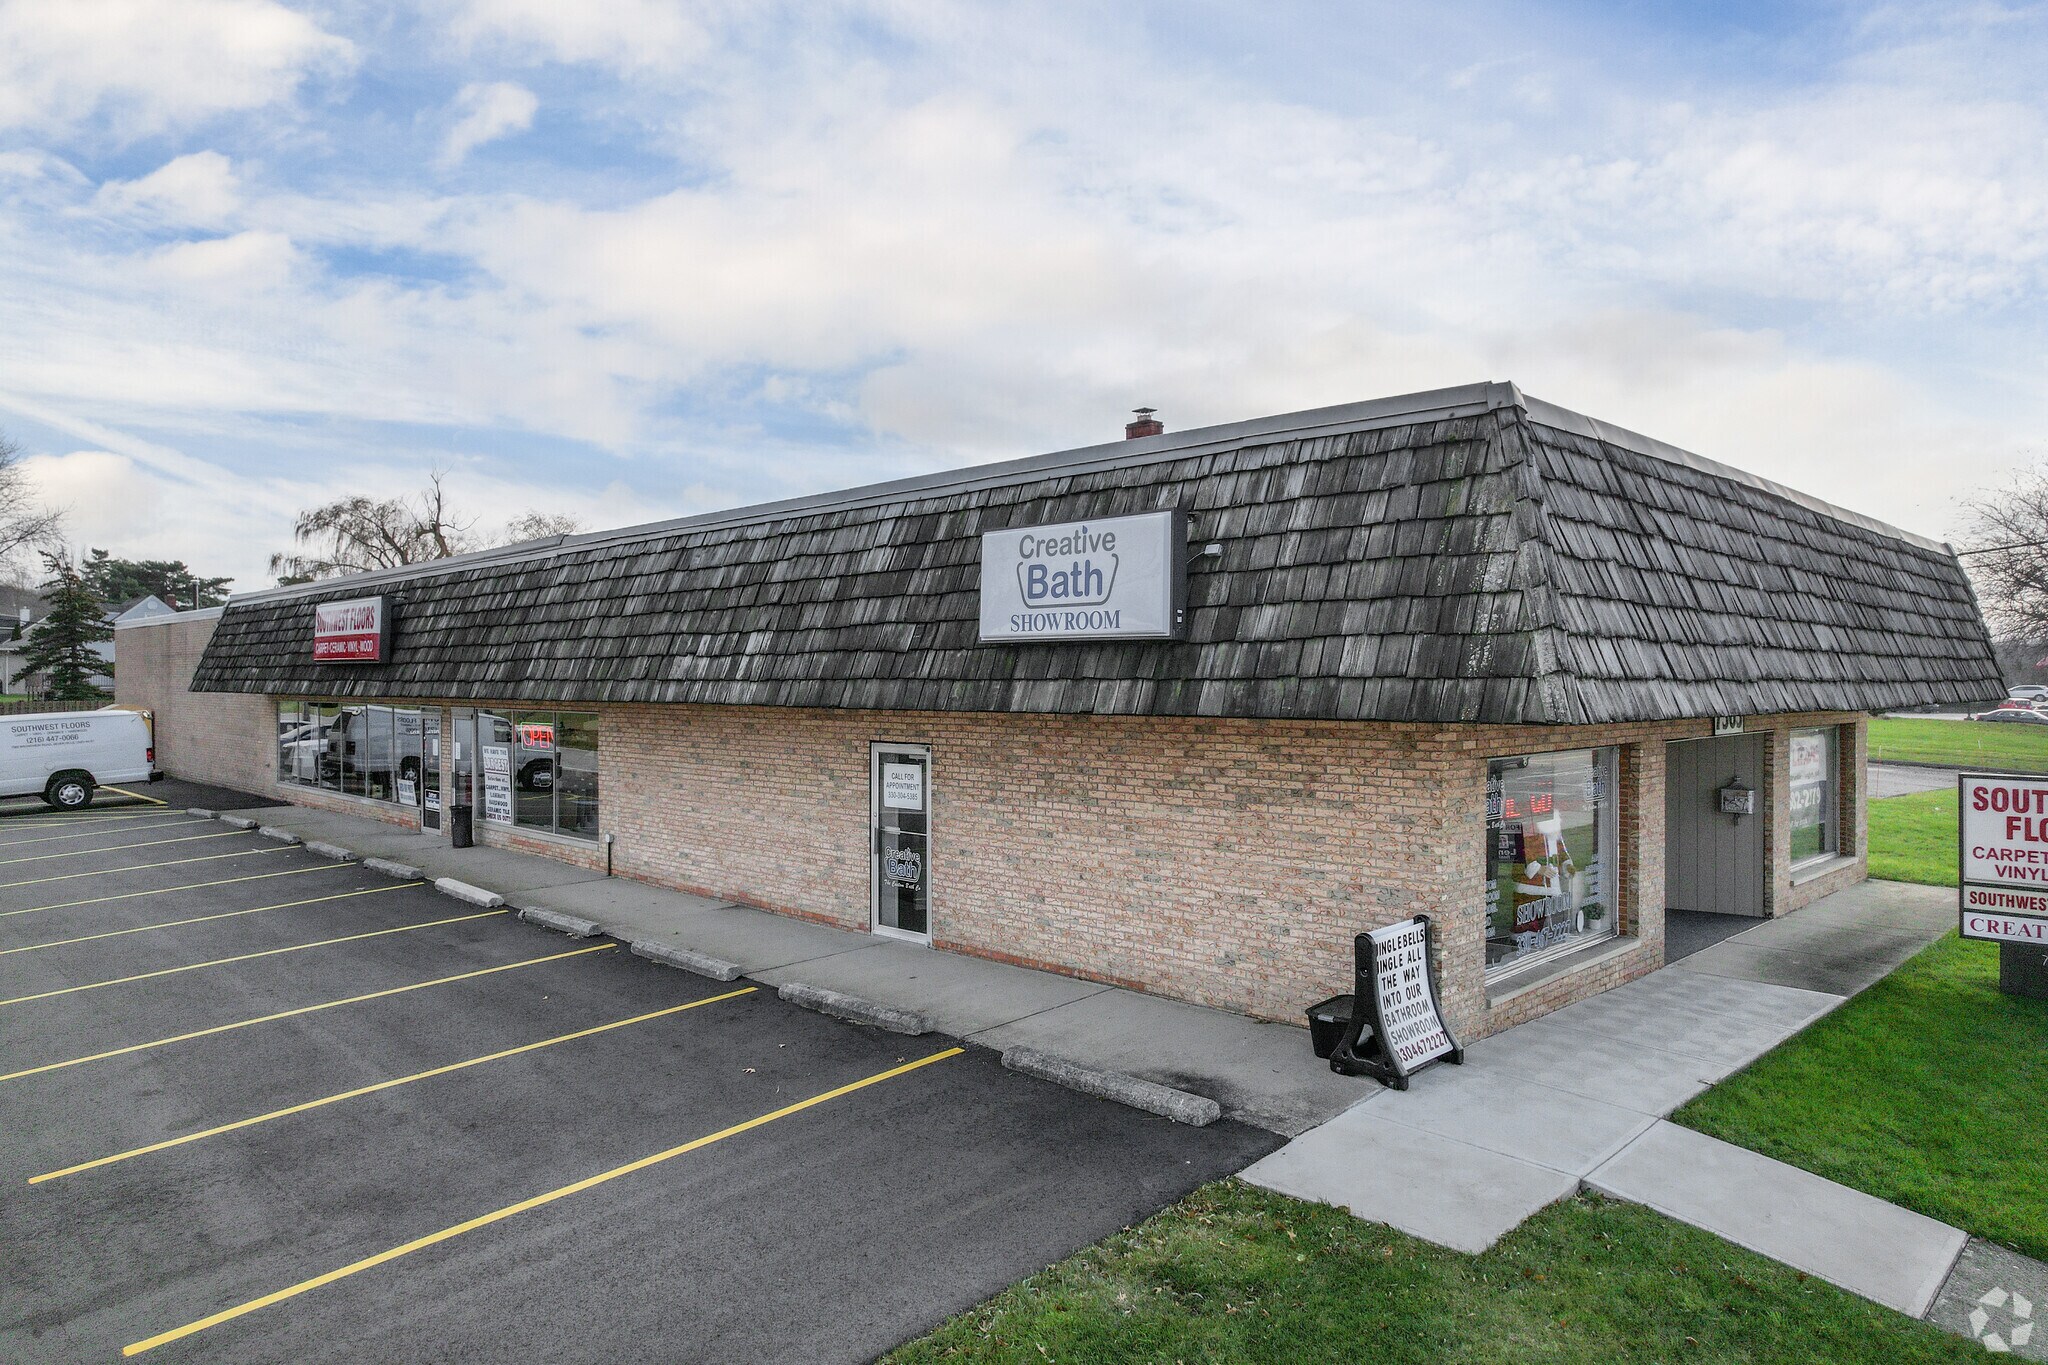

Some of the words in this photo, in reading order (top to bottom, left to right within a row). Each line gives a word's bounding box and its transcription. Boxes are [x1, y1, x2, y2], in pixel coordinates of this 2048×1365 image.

[1019, 525, 1116, 559] Creative
[1027, 559, 1103, 600] Bath
[350, 605, 375, 631] FLOORS
[1010, 609, 1121, 632] SHOWROOM
[11, 723, 59, 733] SOUTHWEST
[61, 721, 91, 729] FLOORS
[522, 725, 554, 748] OPEN
[26, 736, 44, 744] (216)
[886, 782, 920, 791] APPOINTMENT
[891, 772, 904, 780] CALL
[904, 773, 914, 781] FOR
[1972, 786, 2048, 814] SOUT
[885, 846, 920, 862] Creative
[888, 858, 917, 878] Bath
[1994, 864, 2048, 882] VINYL
[1516, 891, 1572, 925] SHOWROOM
[1969, 890, 2048, 911] SOUTHWES
[1969, 917, 2047, 939] CREAT
[1407, 947, 1422, 964] ALL
[1381, 973, 1397, 991] THE
[1403, 965, 1420, 983] WAY
[1382, 990, 1402, 1010] INTO
[1405, 983, 1422, 1001] OUR
[1384, 999, 1431, 1028] BATHROOM
[1390, 1015, 1440, 1045] SHOWROOM
